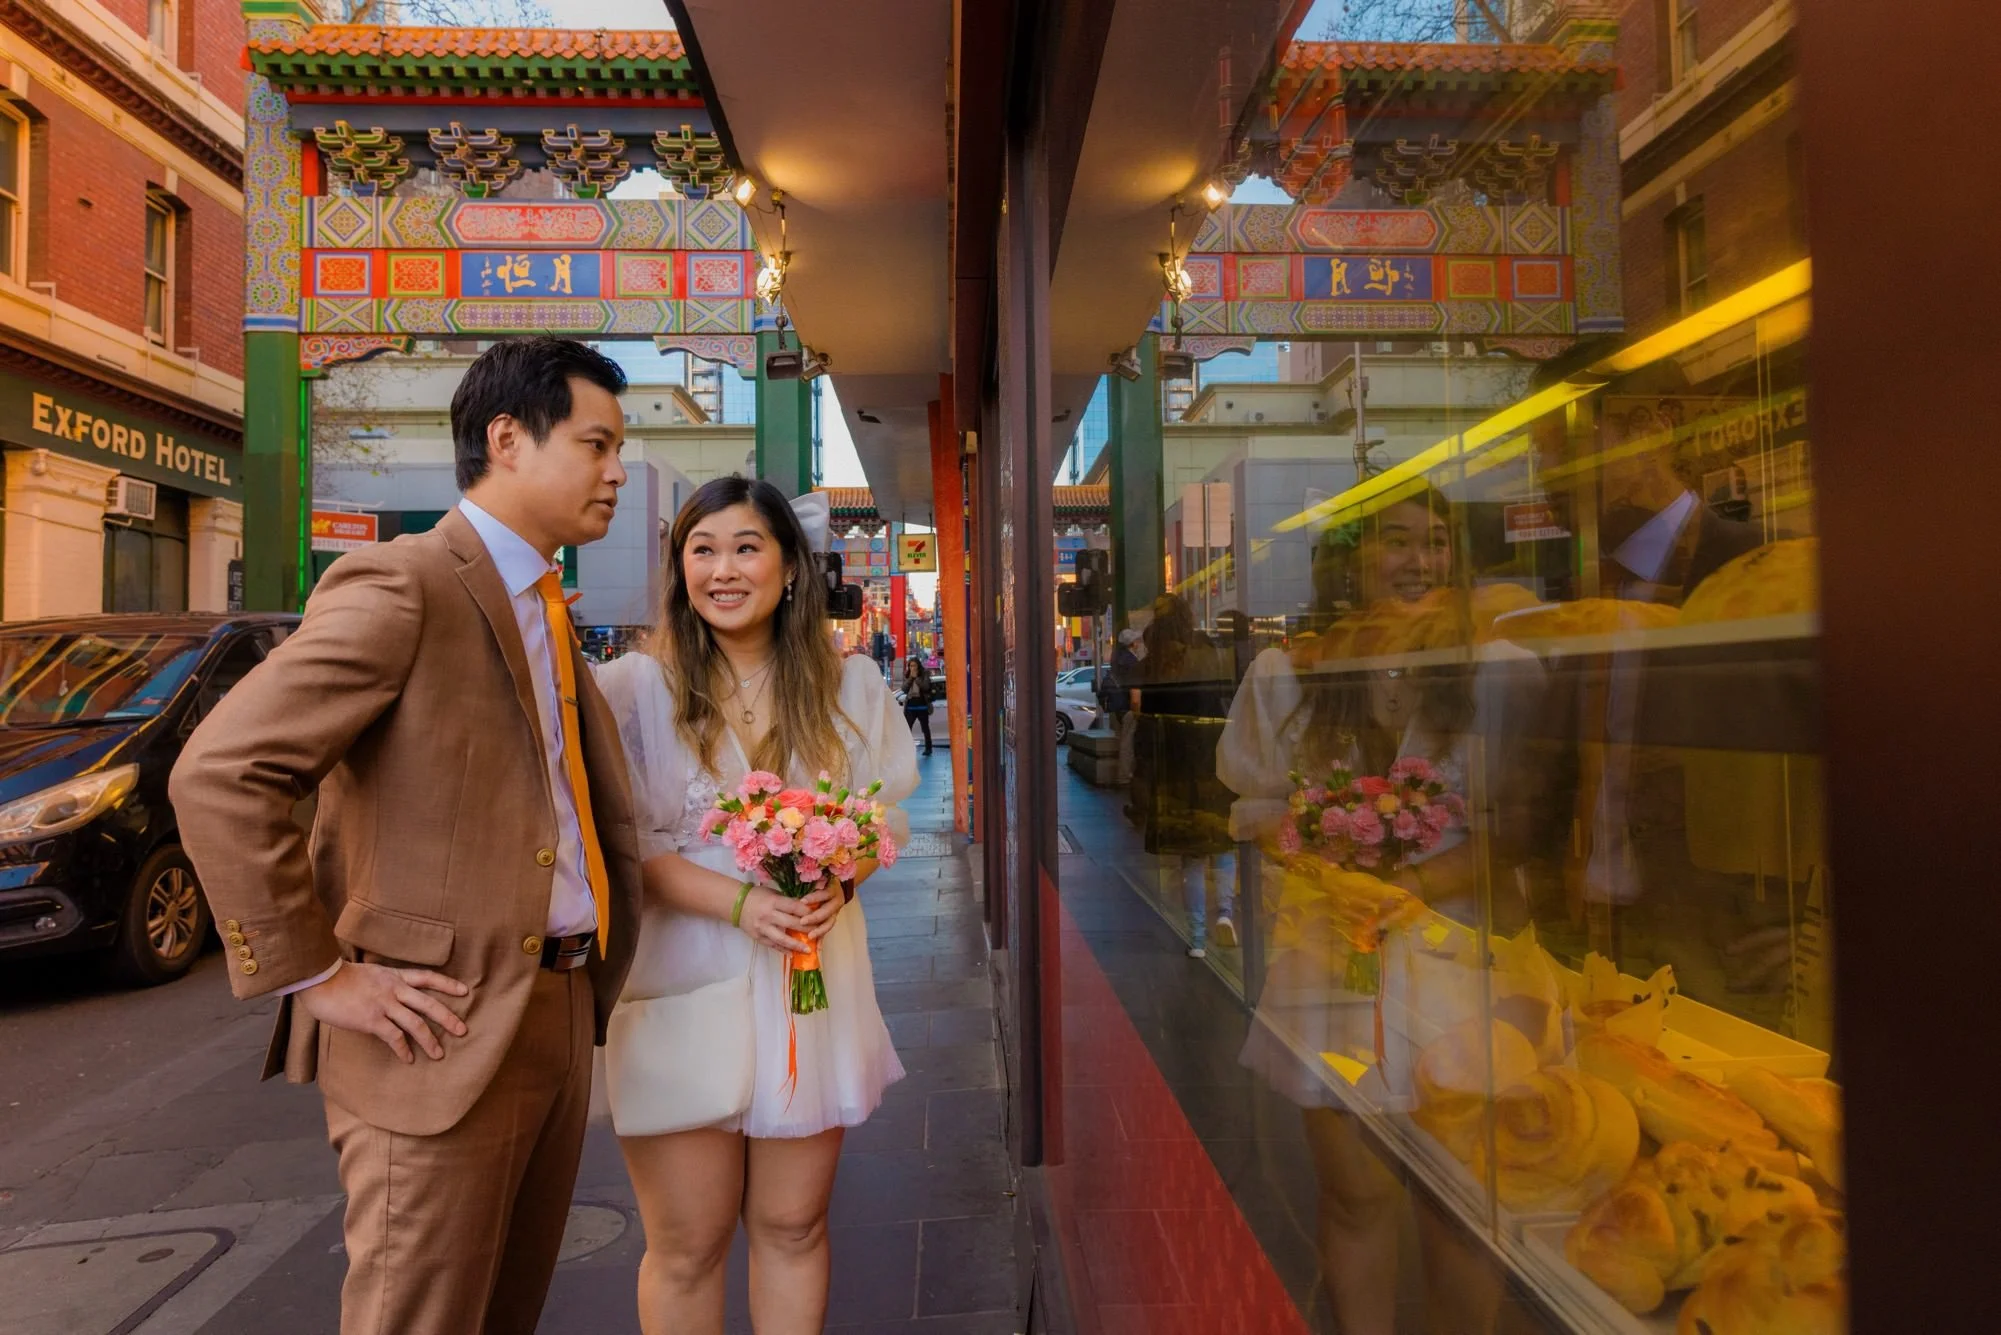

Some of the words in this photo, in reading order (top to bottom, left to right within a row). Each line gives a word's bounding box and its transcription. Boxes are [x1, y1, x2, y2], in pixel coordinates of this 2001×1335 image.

[32, 392, 146, 460] EXFORD
[156, 433, 231, 486] HOTEL
[907, 540, 926, 564] 7
